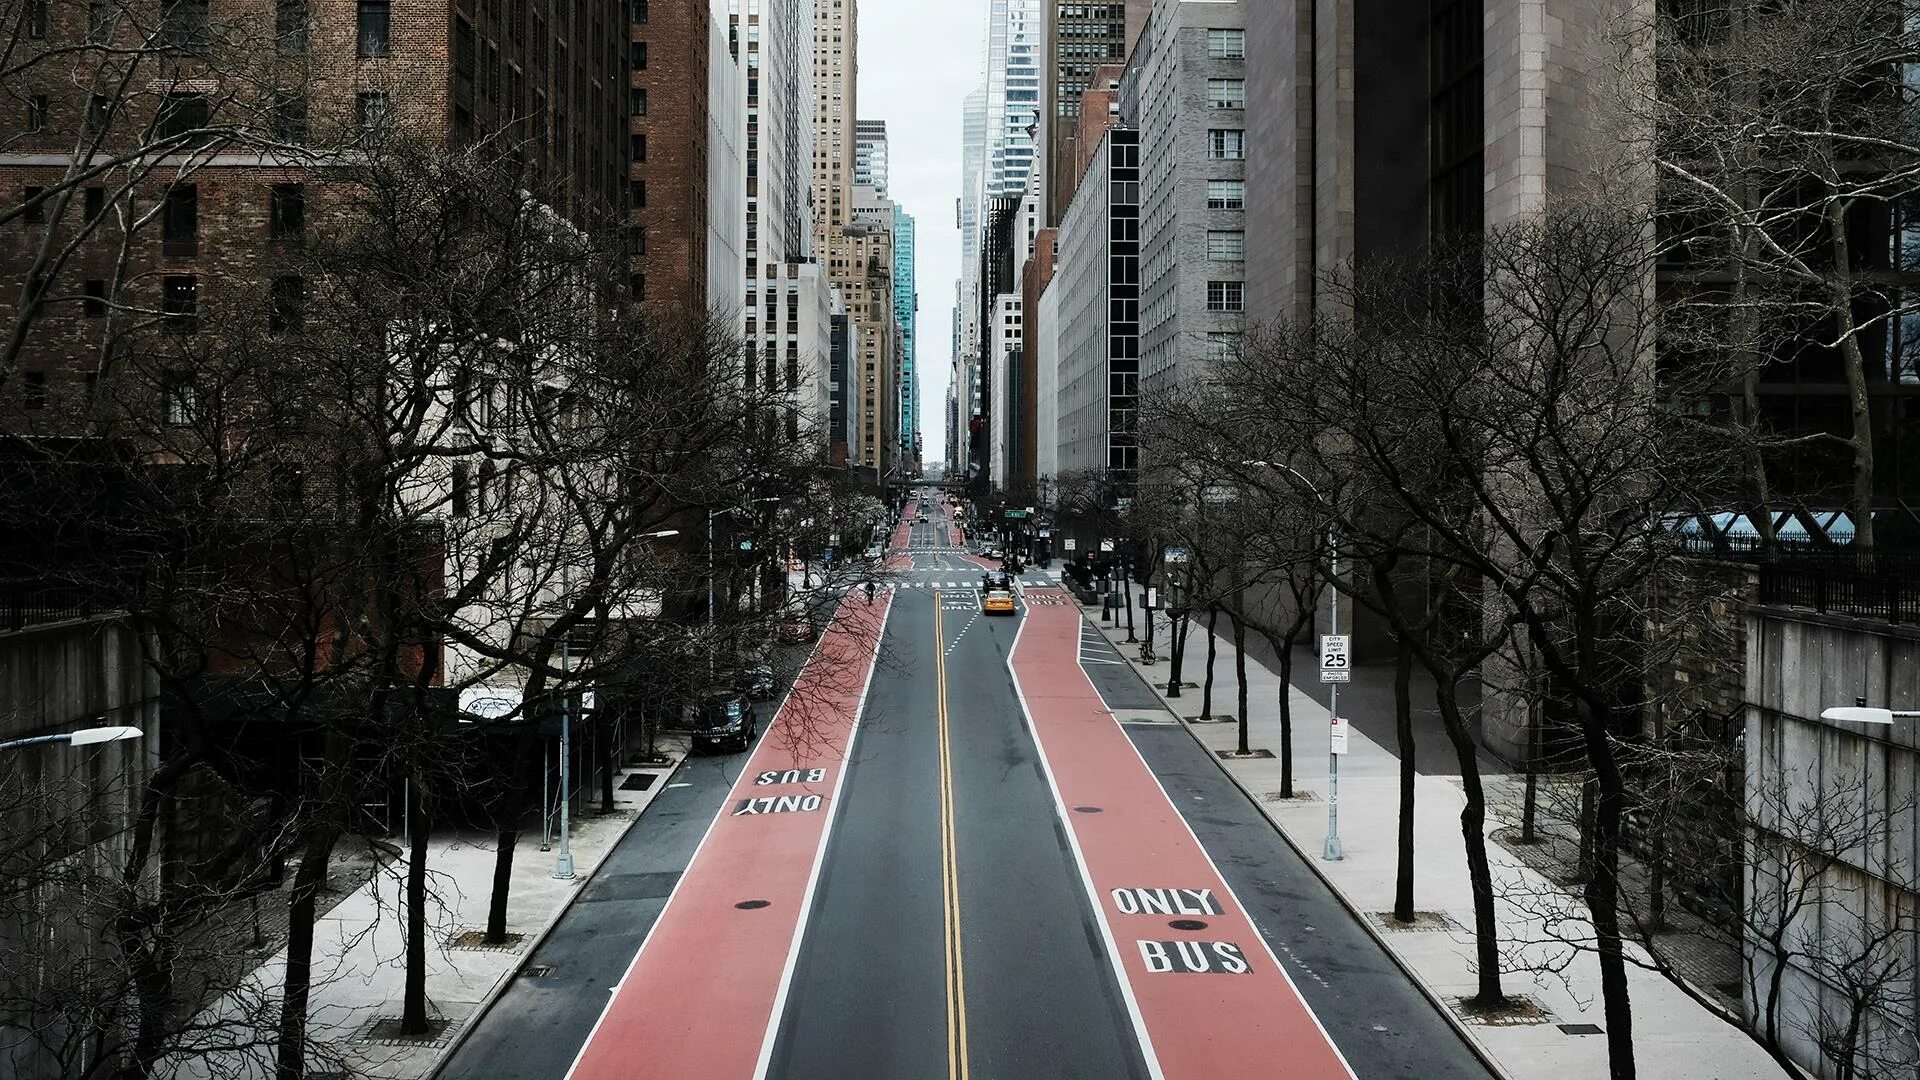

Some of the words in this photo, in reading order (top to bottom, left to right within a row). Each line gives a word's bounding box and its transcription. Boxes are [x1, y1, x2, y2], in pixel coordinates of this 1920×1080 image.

[1325, 654, 1346, 667] 25
[757, 768, 827, 785] BUS
[733, 795, 821, 816] ONLY
[1111, 888, 1215, 916] ONLY
[1136, 939, 1248, 974] BUS
